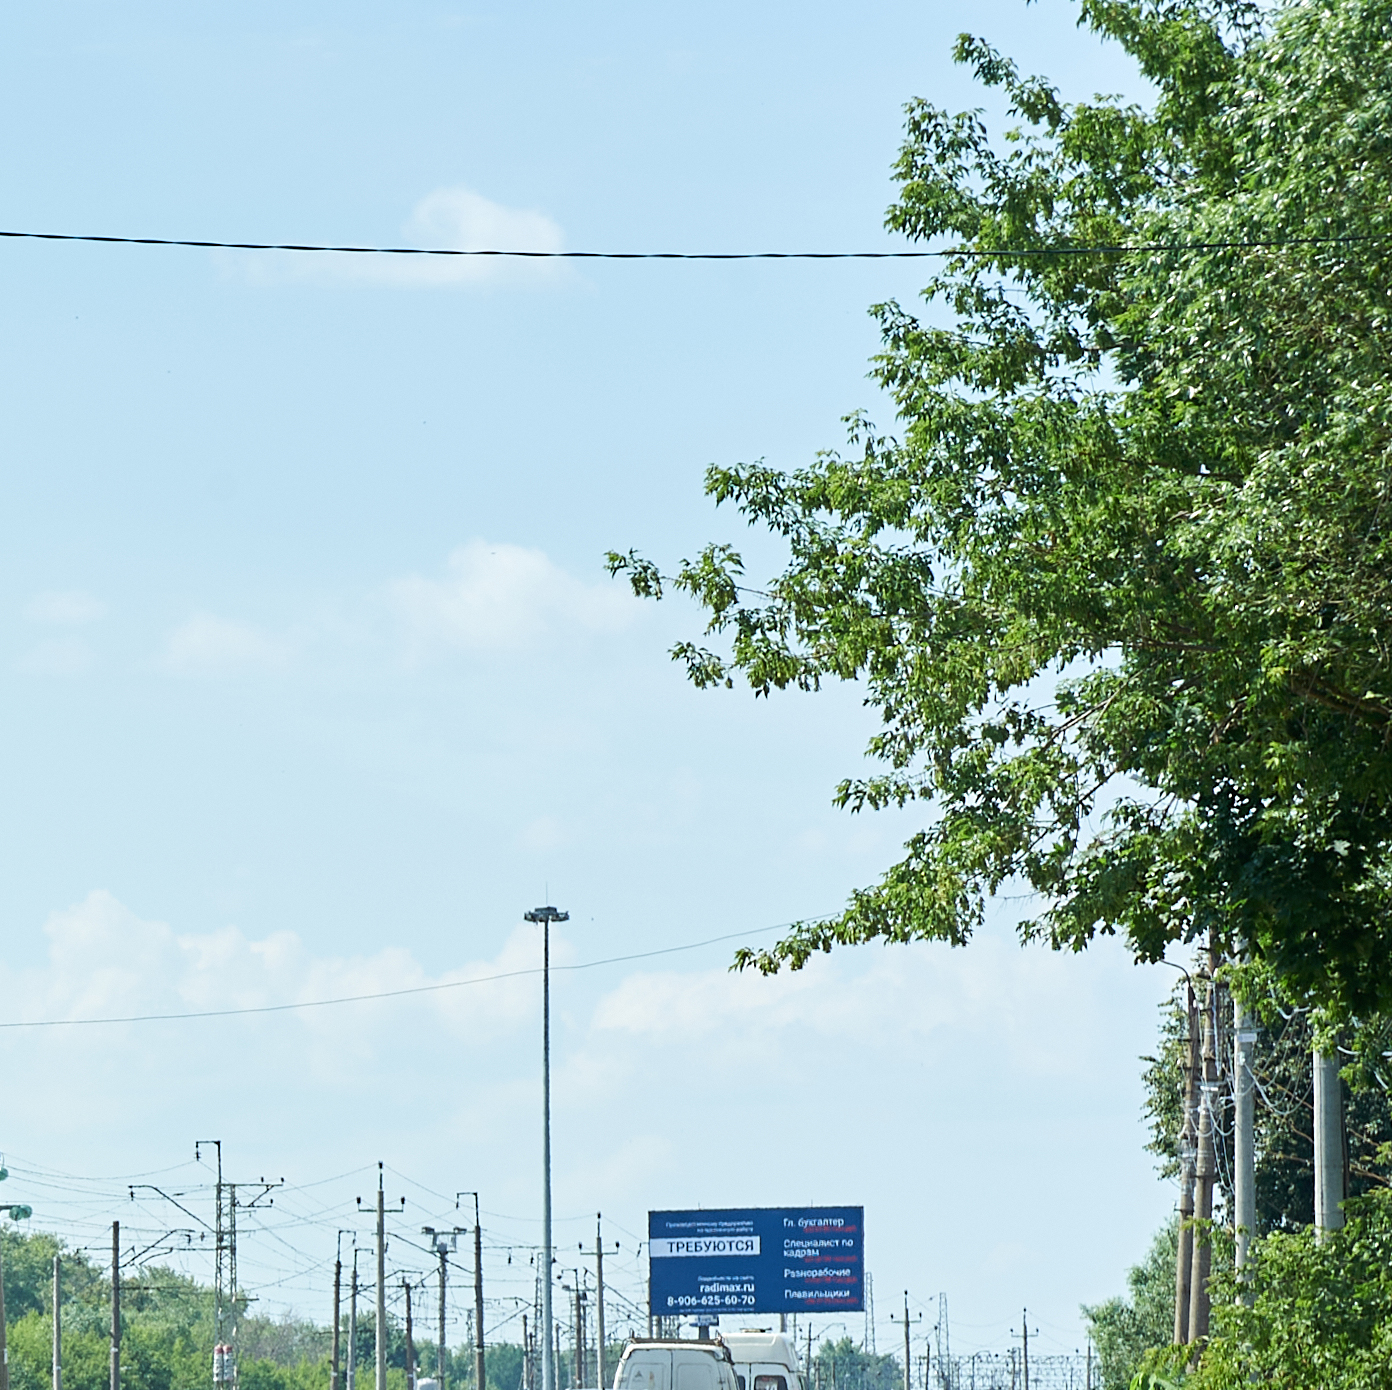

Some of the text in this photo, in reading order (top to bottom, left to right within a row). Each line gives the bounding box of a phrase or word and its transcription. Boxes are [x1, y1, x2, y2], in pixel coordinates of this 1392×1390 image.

[797, 1217, 845, 1229] бухгалтер
[666, 1240, 754, 1253] ТРЕБУЮТСЯ
[783, 1239, 854, 1248] Специалист по
[783, 1249, 820, 1258] кадрам
[784, 1267, 851, 1278] Разнорабочие
[784, 1289, 850, 1299] Плавильщики
[666, 1295, 756, 1307] 8-906-625-60-70
